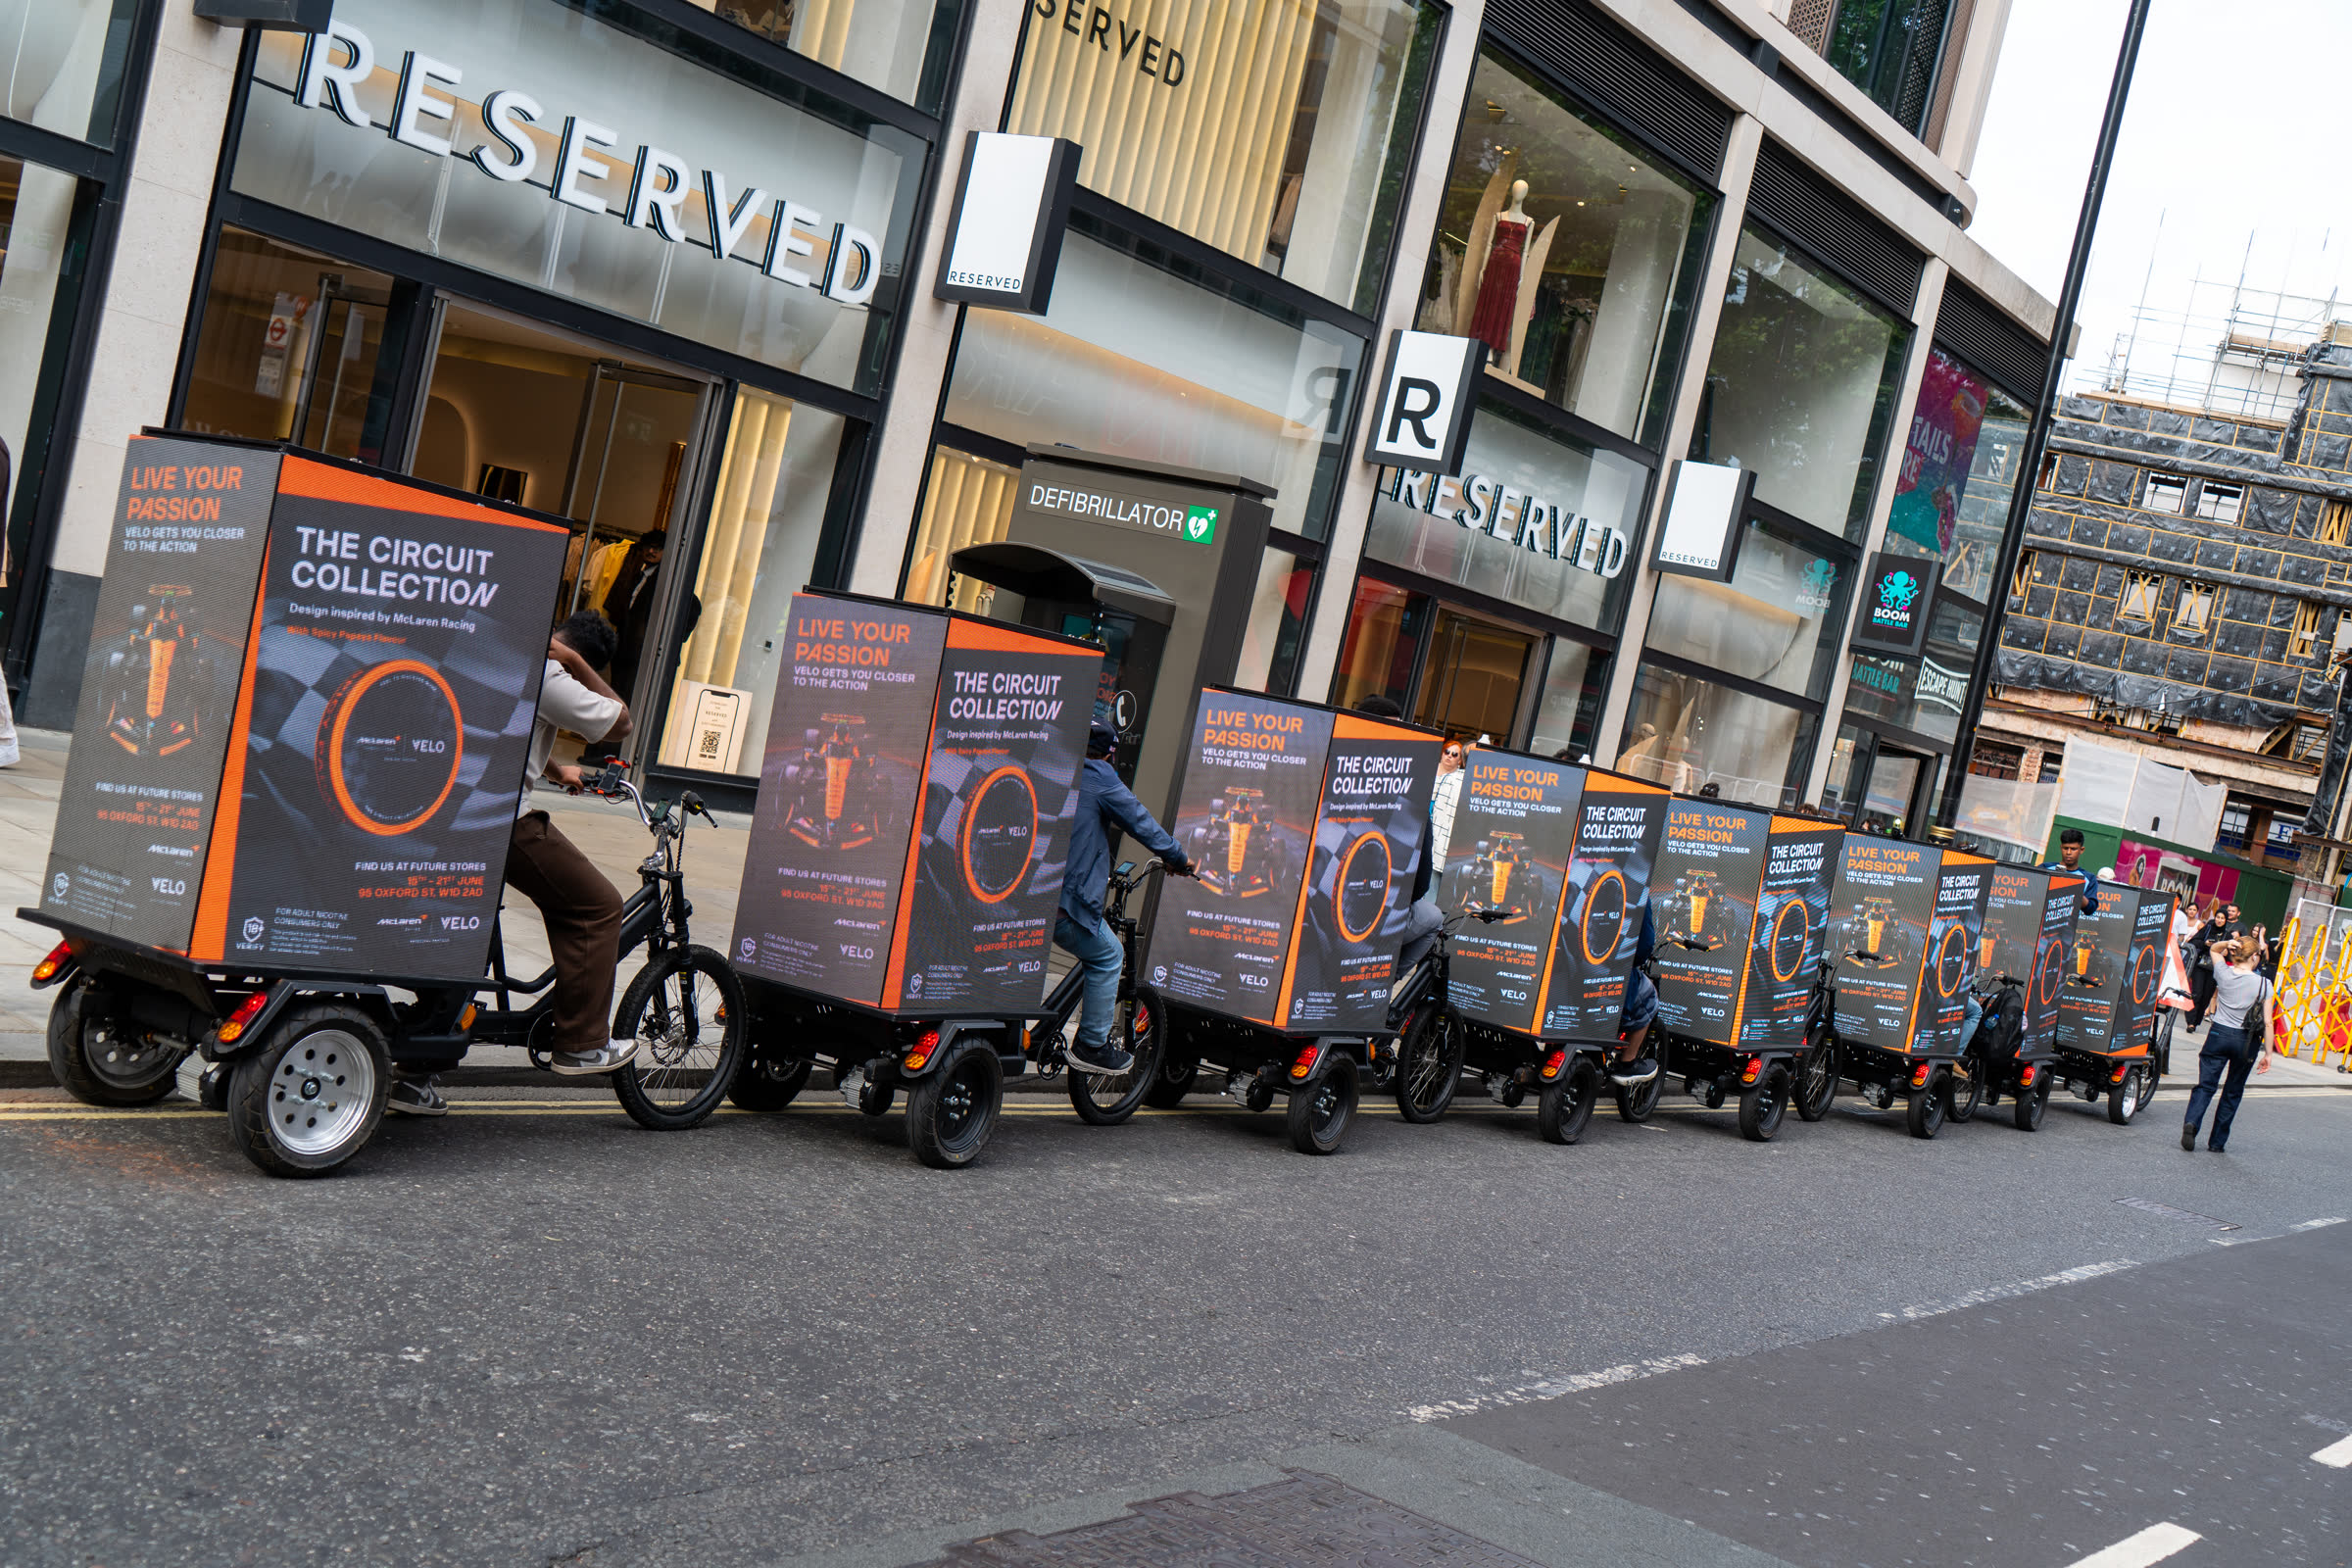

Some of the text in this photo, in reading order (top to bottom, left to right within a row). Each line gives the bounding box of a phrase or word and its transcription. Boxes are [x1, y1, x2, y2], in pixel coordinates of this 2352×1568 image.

[294, 19, 881, 305] RESERVED
[950, 270, 1021, 290] RESERVED
[1386, 376, 1441, 449] R
[130, 466, 243, 490] LIVE YOUR
[126, 497, 221, 520] PASSION
[1030, 485, 1184, 531] DEFIBRILLATOR
[1391, 467, 1628, 579] RESERVED
[125, 526, 244, 539] VELO GETS YOU CLOSER
[123, 540, 197, 553] TO THE ACTION
[296, 525, 494, 576] THE CIRCUIT
[1661, 551, 1718, 567] RESERVED
[291, 560, 499, 608] COLLECTION
[289, 603, 475, 633] Design inspired by McLaren Racing
[1873, 617, 1893, 626] BATTLE
[1874, 607, 1910, 622] BOOM
[798, 618, 911, 644] LIVE YOUR
[795, 642, 890, 666] PASSION
[794, 665, 915, 683] VELO GETS YOU CLOSER
[1851, 662, 1880, 687] BATTLE
[1882, 672, 1900, 694] BAR
[793, 676, 868, 691] TO THE ACTION
[954, 670, 1061, 696] THE CIRCUIT
[1920, 666, 1968, 705] ESCAPE HUNT
[949, 697, 1063, 720] COLLECTION
[1206, 709, 1303, 733] LIVE YOUR
[412, 739, 445, 753] VELO
[1203, 728, 1286, 752] PASSION
[1201, 756, 1267, 770] TO THE ACTION
[1202, 747, 1306, 765] VELO GETS YOU CLOSER
[1337, 756, 1413, 774] THE CIRCUIT
[1473, 764, 1559, 787] LIVE YOUR
[1332, 776, 1413, 795] COLLECTION
[1471, 781, 1543, 802] PASSION
[1469, 804, 1527, 817] TO THE ACTION
[1470, 797, 1562, 814] VELO GETS YOU CLOSER
[1587, 806, 1646, 822] THE CIRCUIT
[1670, 811, 1747, 831] LIVE YOUR
[1583, 824, 1645, 839] COLLECTION
[1668, 826, 1733, 844] PASSION
[1692, 849, 1719, 858] ACTION
[1722, 846, 1750, 855] CLOSER
[1772, 843, 1824, 858] THE CIRCUIT
[1849, 846, 1920, 862] LIVE YOUR
[355, 862, 378, 871] FIND
[380, 862, 395, 871] US
[411, 862, 447, 871] FUTURE
[449, 862, 486, 871] STORES
[1769, 858, 1824, 874] COLLECTION
[1847, 858, 1907, 874] PASSION
[778, 867, 797, 877] FIND
[809, 870, 821, 879] AT
[821, 872, 853, 883] FUTURE
[855, 876, 887, 888] STORES
[1942, 875, 1981, 888] THE CIRCUIT
[1994, 874, 2030, 887] YOUR
[152, 877, 186, 896] VELO
[374, 888, 419, 898] OXFORD
[1939, 888, 1980, 902] COLLECTION
[2057, 895, 2075, 906] CIRCUIT
[2045, 906, 2074, 921] COLLECTION
[2140, 904, 2167, 915] THE CIRCUIT
[441, 916, 480, 930] VELO
[2137, 913, 2167, 927] COLLECTION
[840, 943, 874, 959] VELO
[1513, 942, 1538, 952] STORES
[1234, 952, 1275, 963] McLaren
[1018, 960, 1041, 973] VELO
[1240, 973, 1269, 987] VELO
[1496, 971, 1532, 981] McLaren
[1371, 989, 1388, 999] VELO
[1500, 988, 1527, 1000] VELO
[1701, 1006, 1725, 1017] VELO
[1879, 1017, 1899, 1027] VELO
